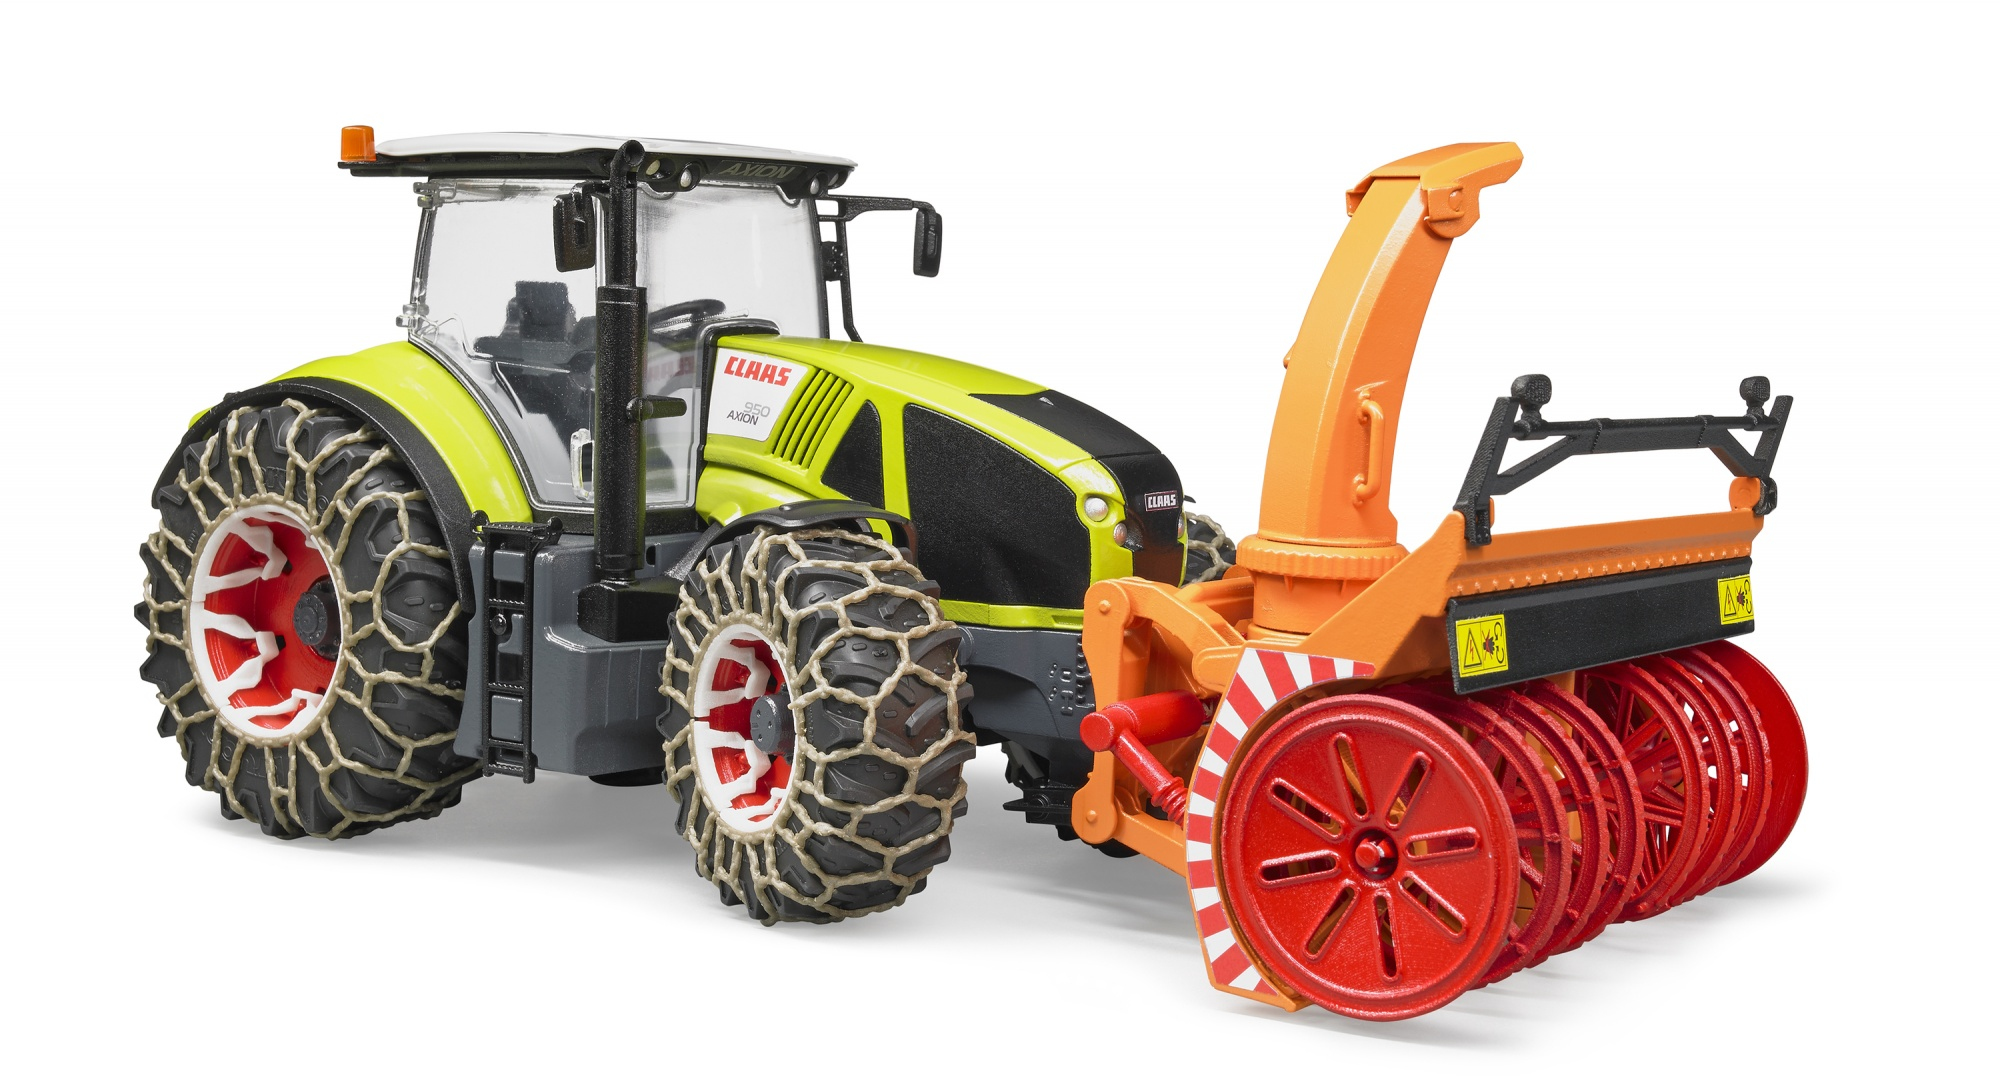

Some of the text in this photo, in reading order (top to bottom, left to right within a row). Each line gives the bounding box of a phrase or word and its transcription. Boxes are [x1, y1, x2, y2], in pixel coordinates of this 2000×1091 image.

[719, 162, 795, 178] AXION
[724, 356, 792, 387] CLAAS
[726, 409, 759, 426] AXION
[743, 401, 771, 418] 950
[1147, 494, 1177, 508] CLAAS
